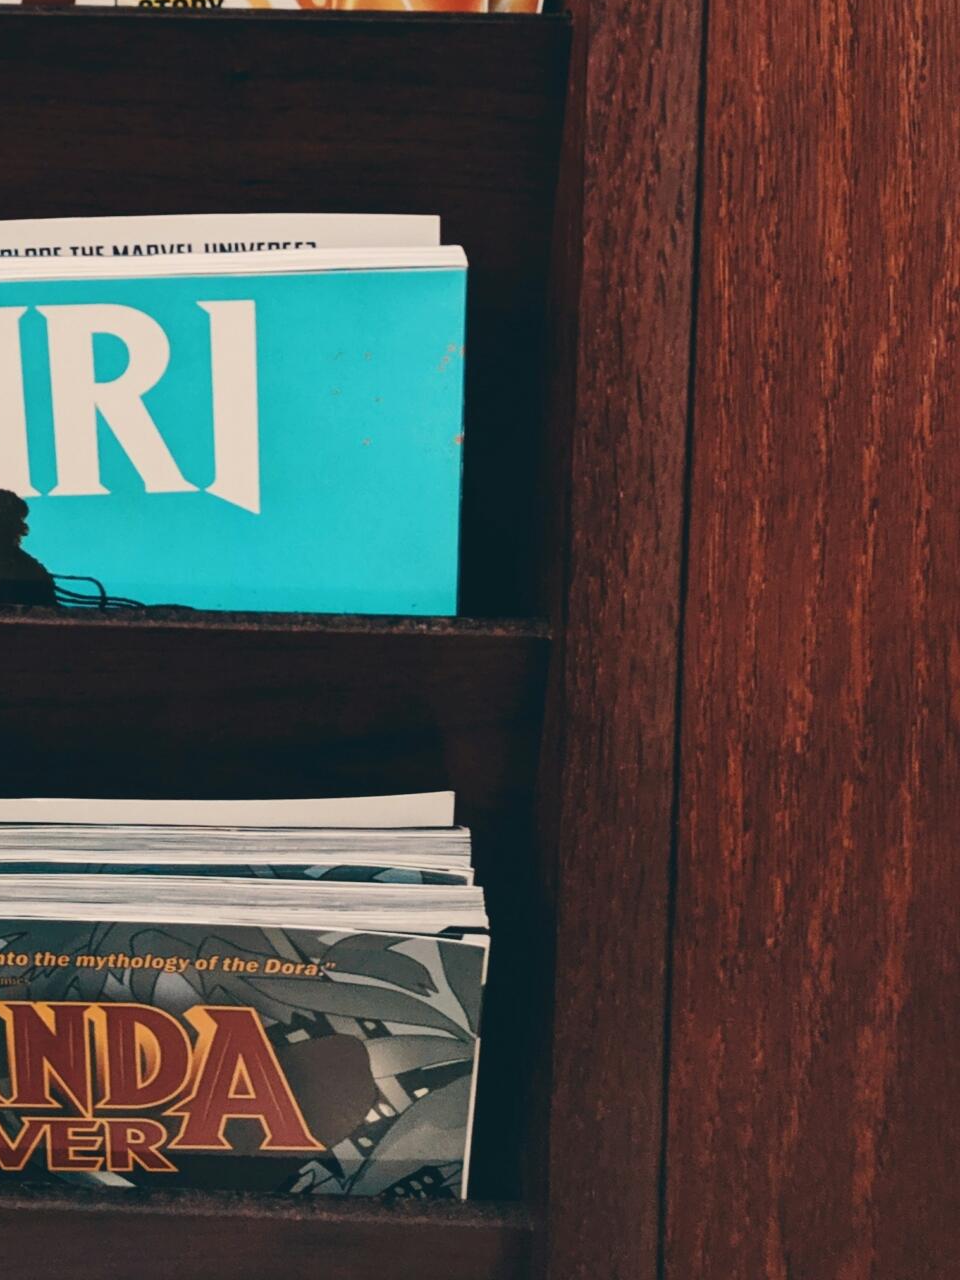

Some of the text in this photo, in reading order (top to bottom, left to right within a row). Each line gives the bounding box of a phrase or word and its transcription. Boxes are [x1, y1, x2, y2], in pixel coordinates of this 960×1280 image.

[35, 951, 69, 968] the
[75, 954, 189, 973] mythology
[195, 955, 219, 972] of
[223, 957, 258, 973] the
